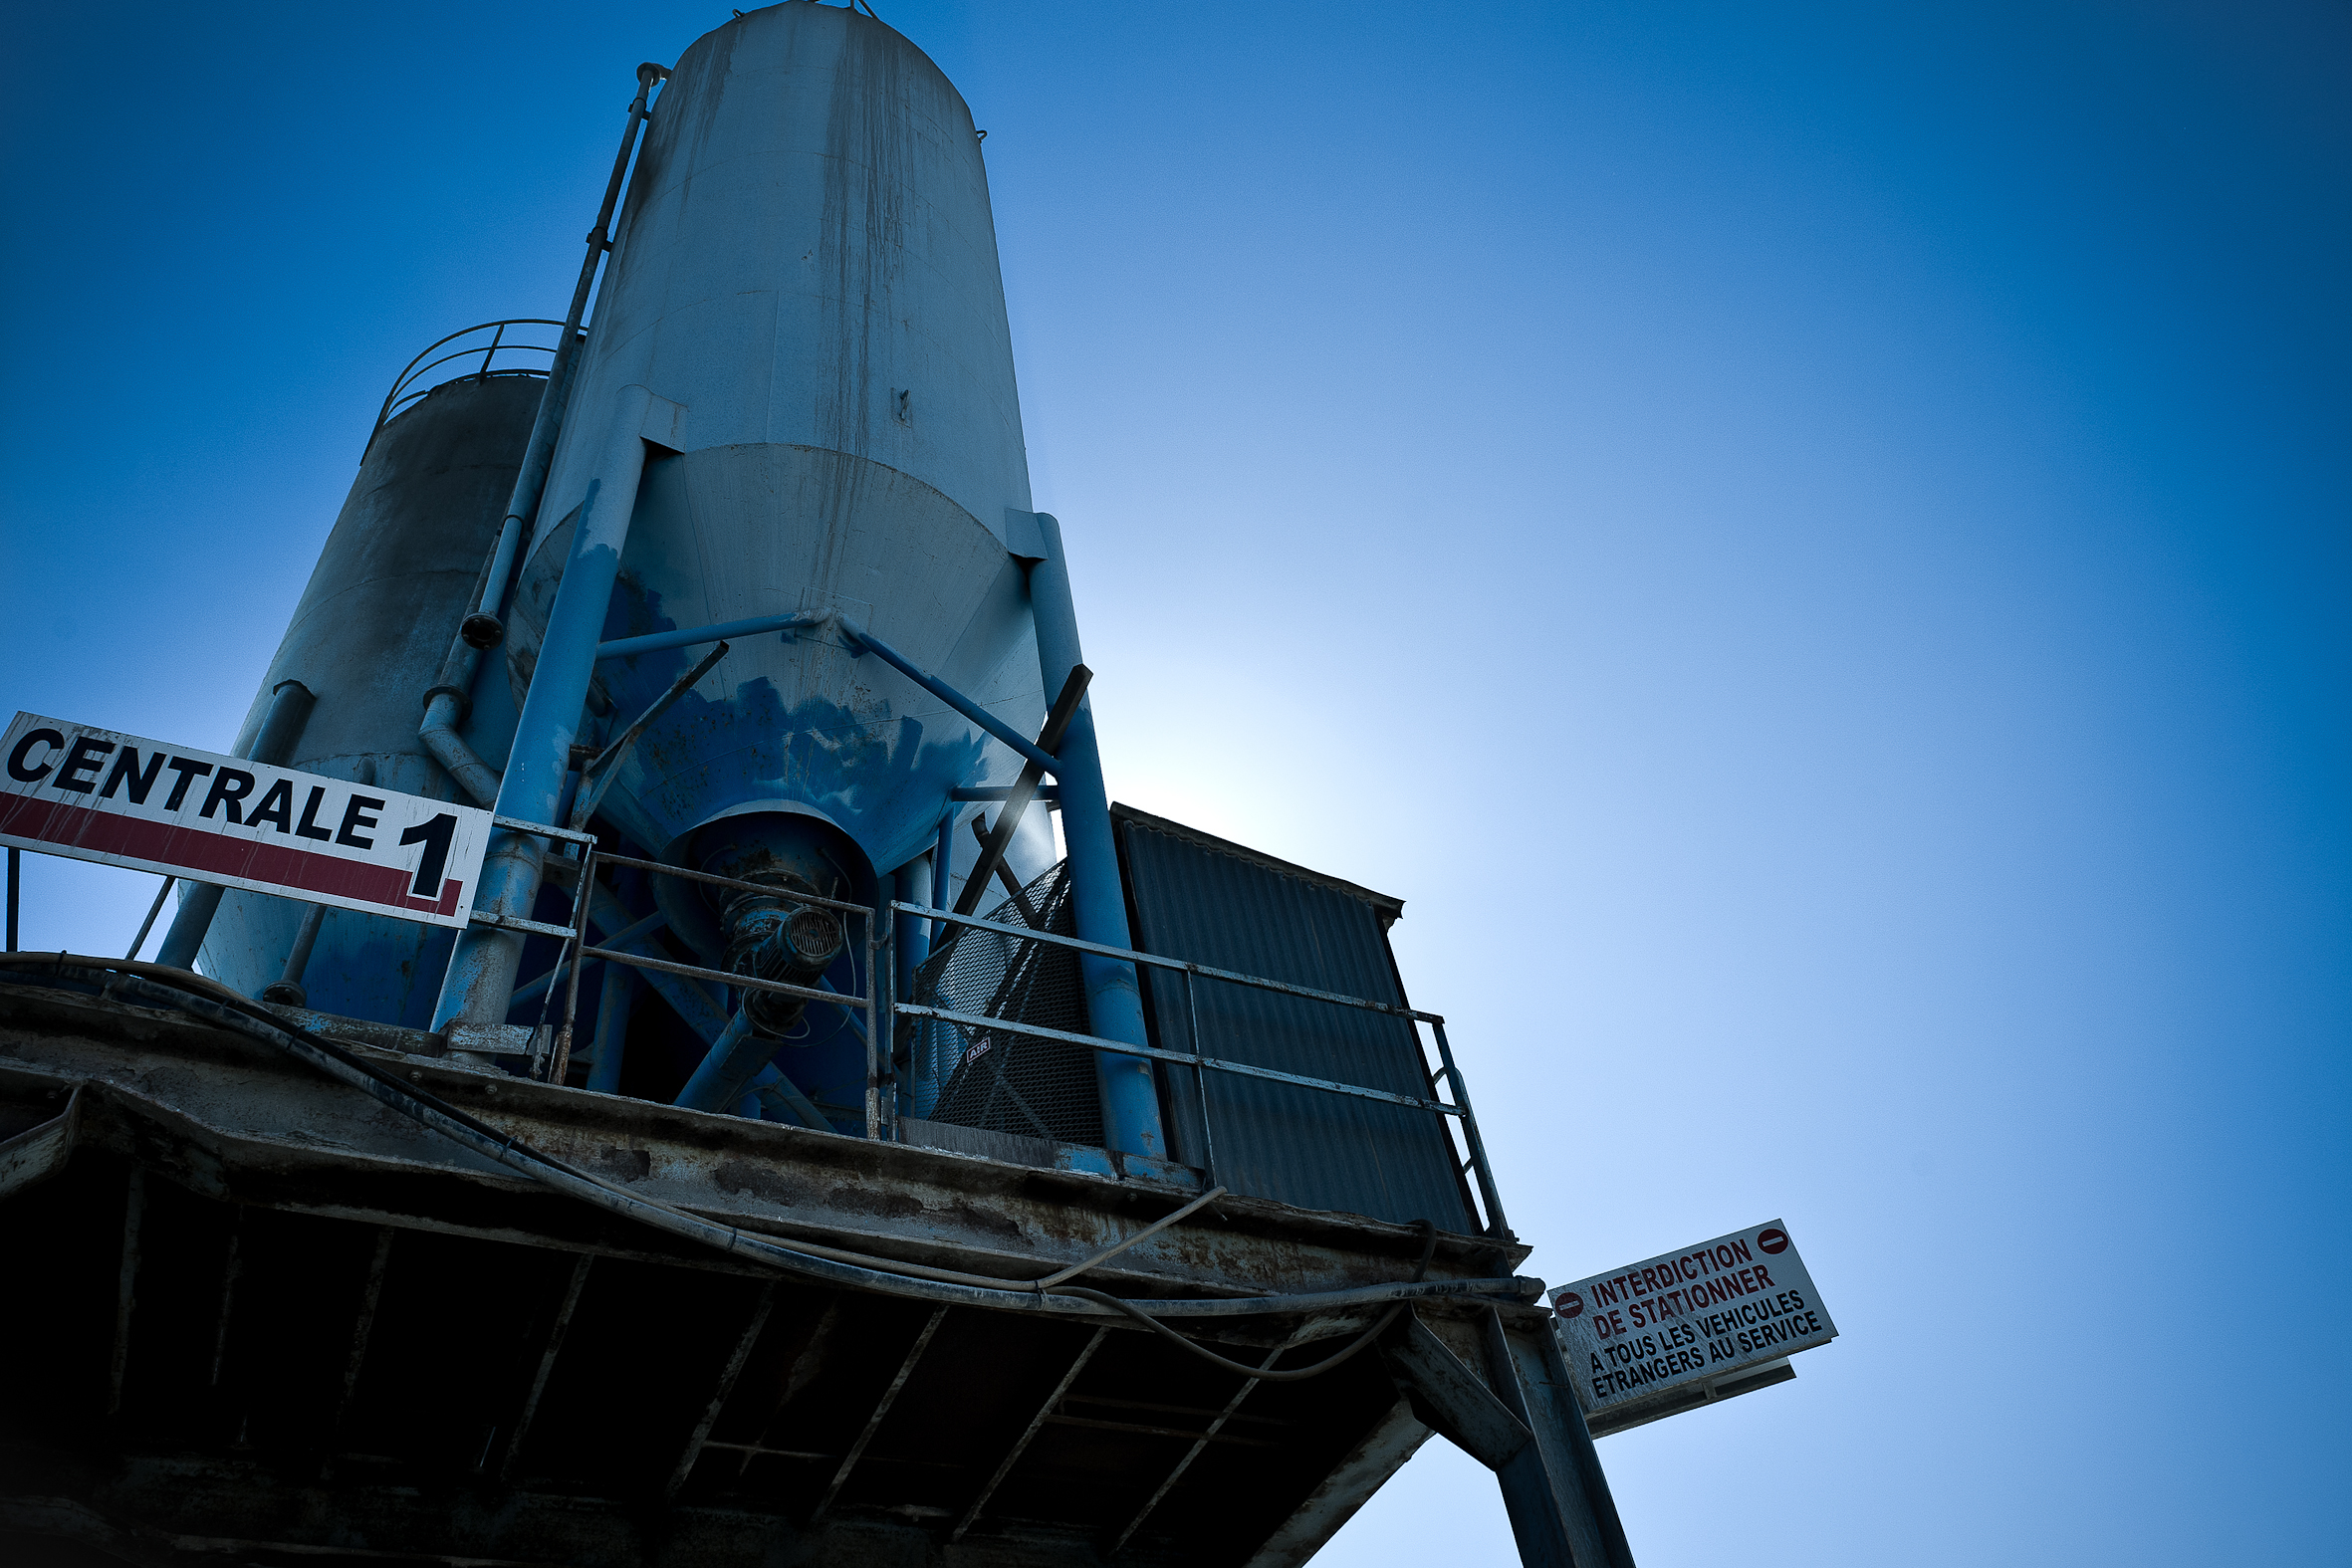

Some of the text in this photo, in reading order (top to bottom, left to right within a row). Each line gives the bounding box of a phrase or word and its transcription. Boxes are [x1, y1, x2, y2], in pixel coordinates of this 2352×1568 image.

[7, 728, 458, 898] CENTRALE 1
[969, 1042, 988, 1059] AIR
[1590, 1238, 1754, 1308] INTERDICTION
[1593, 1264, 1775, 1340] DE STATIONNER
[1590, 1289, 1805, 1374] A TOUS LES VEHICULES
[1591, 1311, 1822, 1399] ETRANGERS AU SERVICE
